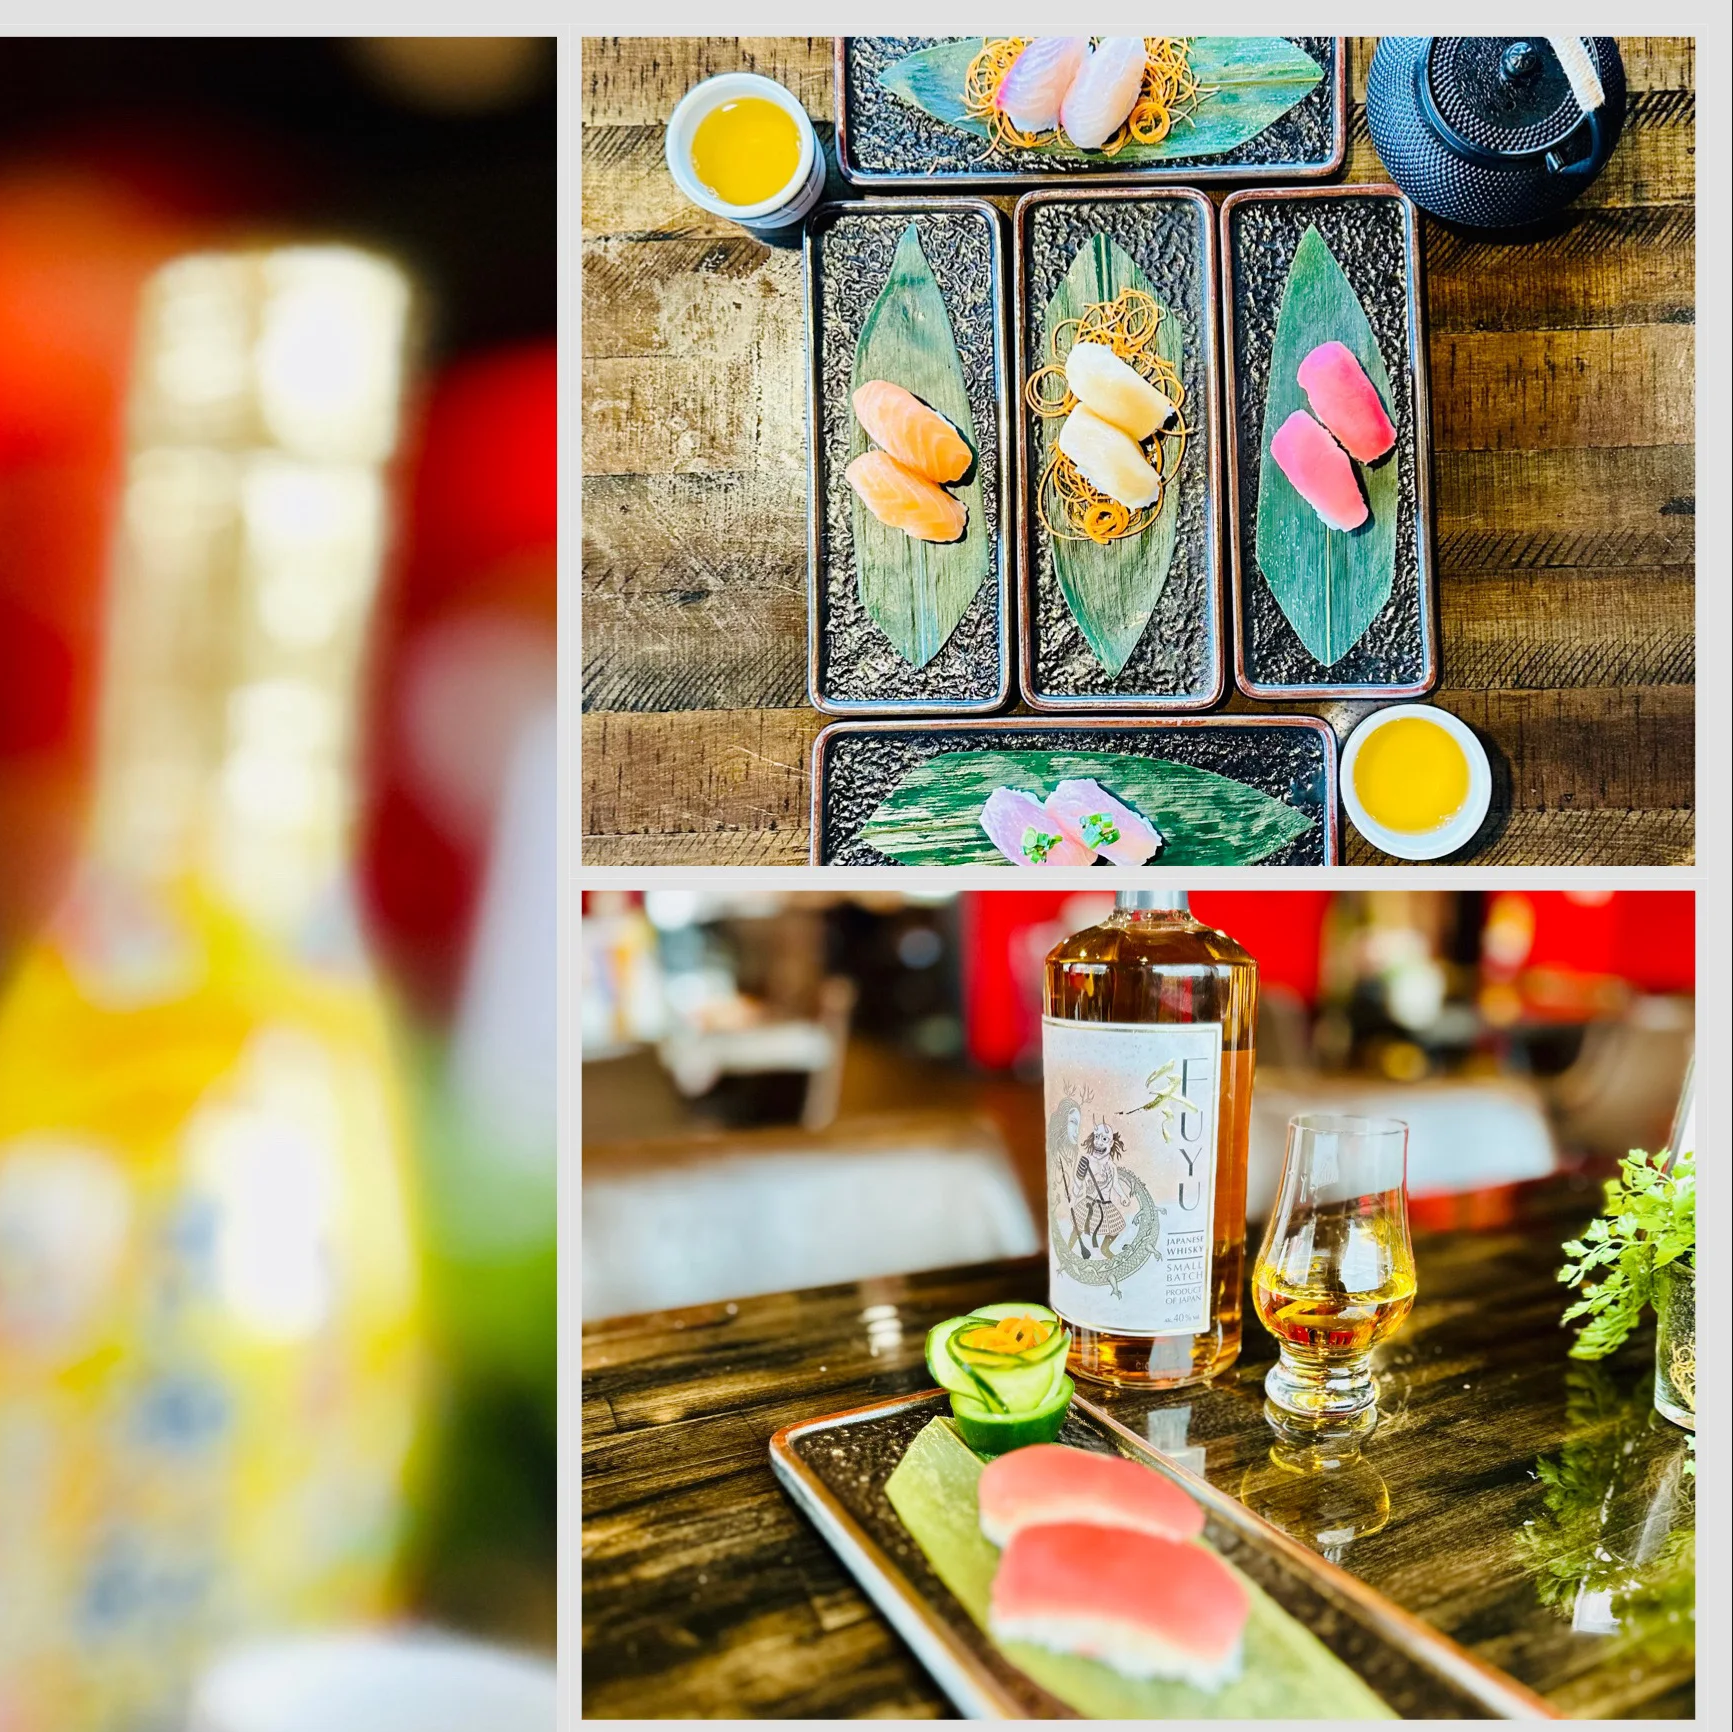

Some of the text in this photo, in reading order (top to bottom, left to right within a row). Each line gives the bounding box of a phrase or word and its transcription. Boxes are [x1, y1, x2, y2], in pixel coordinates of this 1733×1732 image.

[1179, 1057, 1208, 1212] FUYU
[1166, 1235, 1204, 1246] JAPANESE
[1166, 1245, 1204, 1256] WHISKY
[1166, 1261, 1203, 1272] SMALL
[1166, 1271, 1204, 1282] BATCH
[1165, 1286, 1202, 1296] PRODUCT
[1165, 1295, 1202, 1305] OF JAPAN
